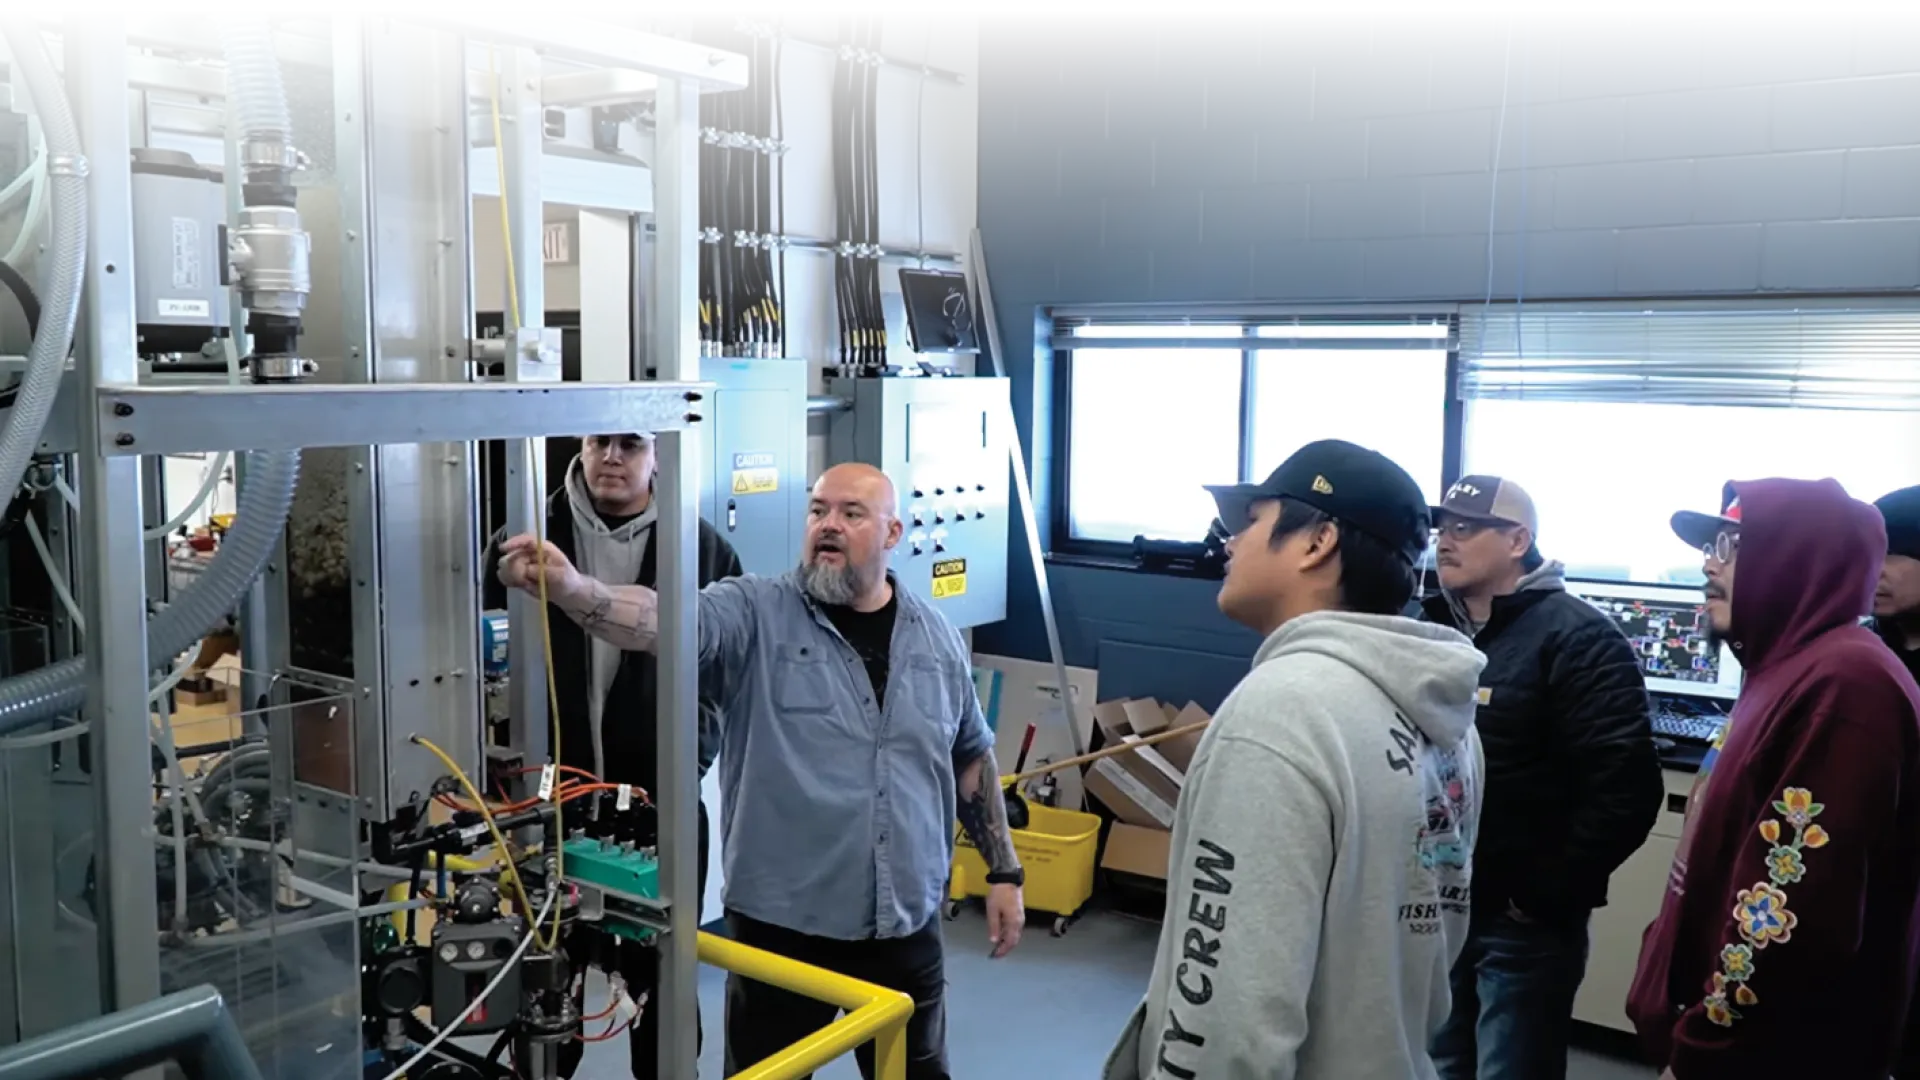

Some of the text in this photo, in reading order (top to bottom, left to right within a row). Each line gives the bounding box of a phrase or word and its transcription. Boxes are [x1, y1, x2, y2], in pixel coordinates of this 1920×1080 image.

[935, 561, 964, 576] CAUTION
[1386, 711, 1418, 777] SAL
[1398, 902, 1438, 921] FISH
[1152, 838, 1236, 1080] TY CREW
